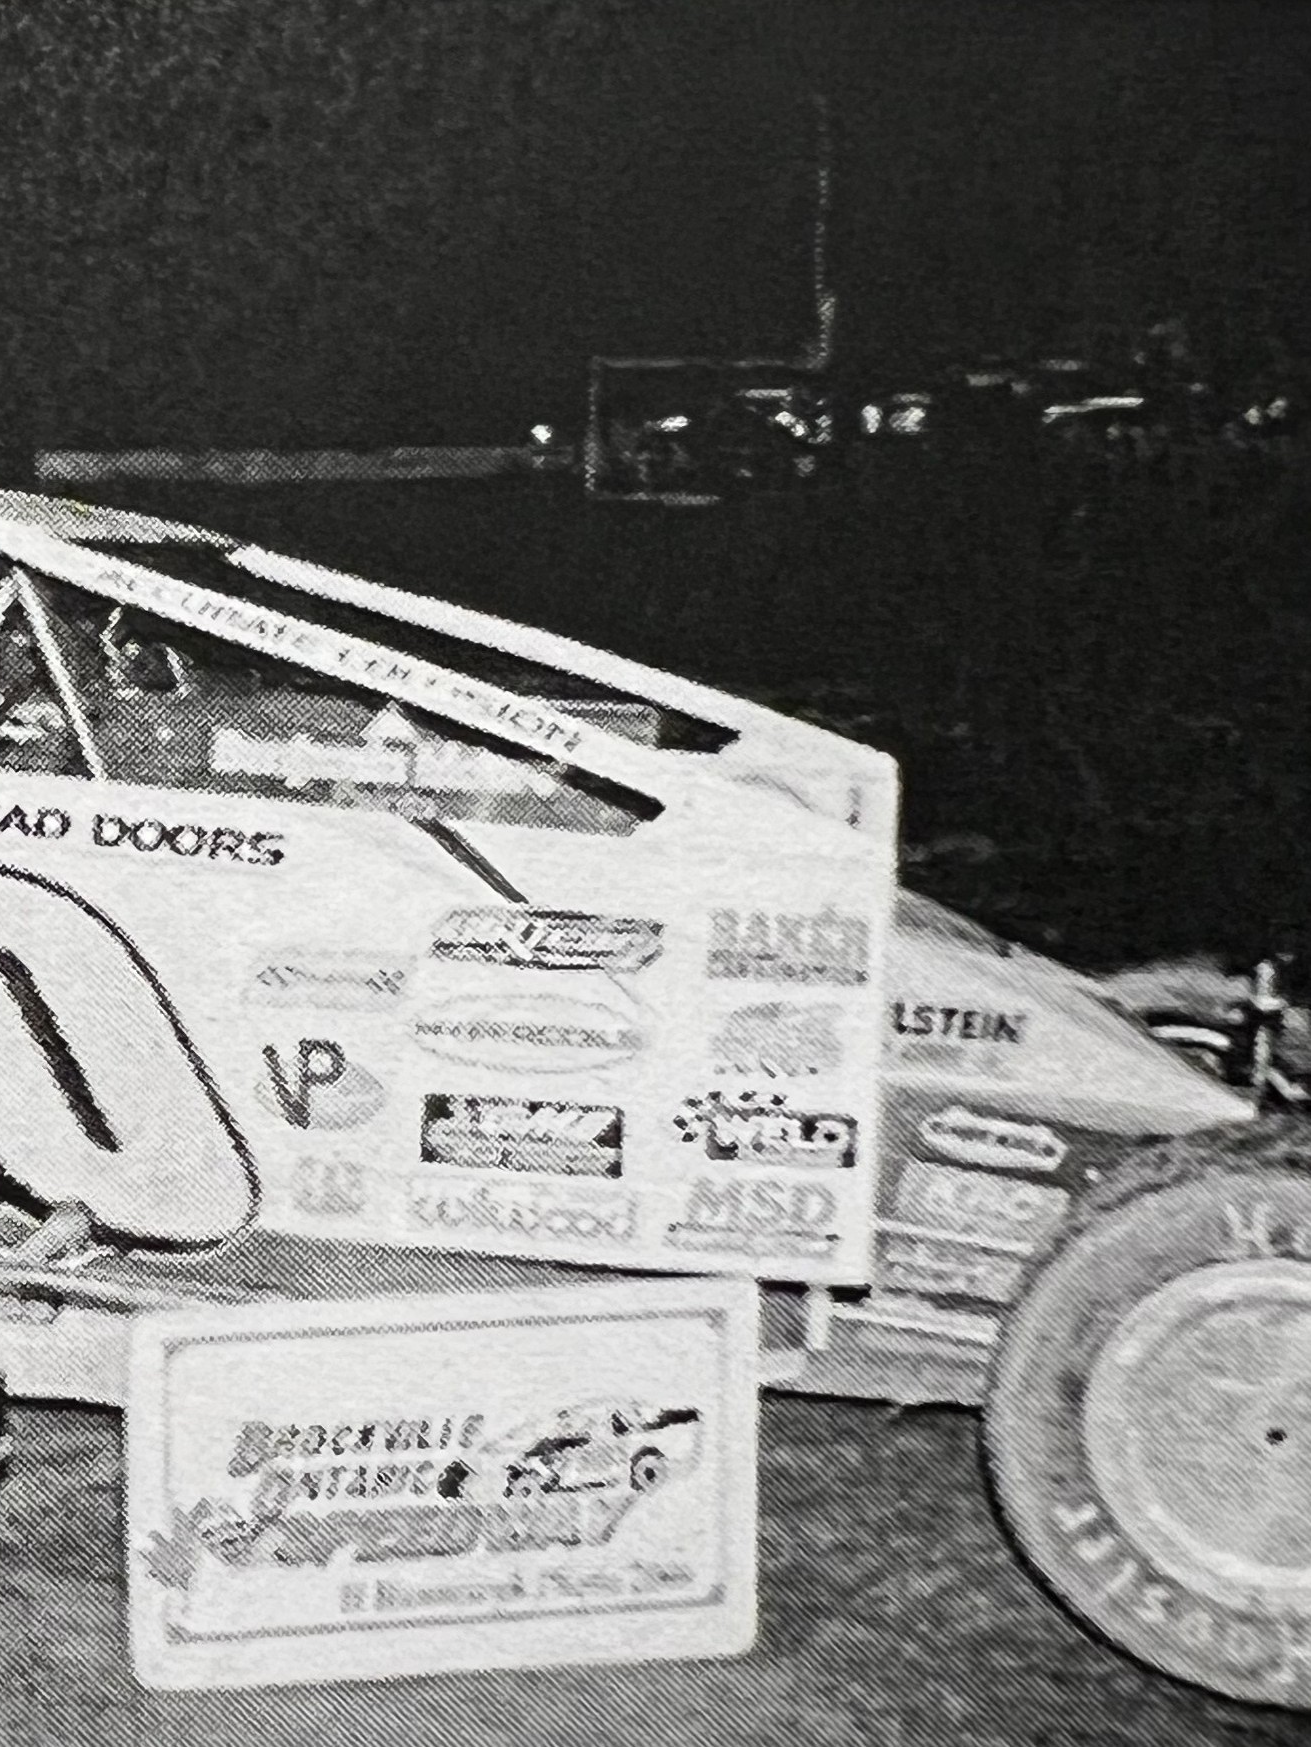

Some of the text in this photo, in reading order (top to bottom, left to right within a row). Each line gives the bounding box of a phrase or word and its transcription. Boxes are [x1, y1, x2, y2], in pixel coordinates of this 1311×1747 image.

[92, 813, 285, 865] DOORS
[891, 1000, 1027, 1044] LSTEIN
[260, 1037, 346, 1130] VP
[687, 1176, 838, 1229] MSD
[228, 1413, 484, 1478] BROCKVILLE
